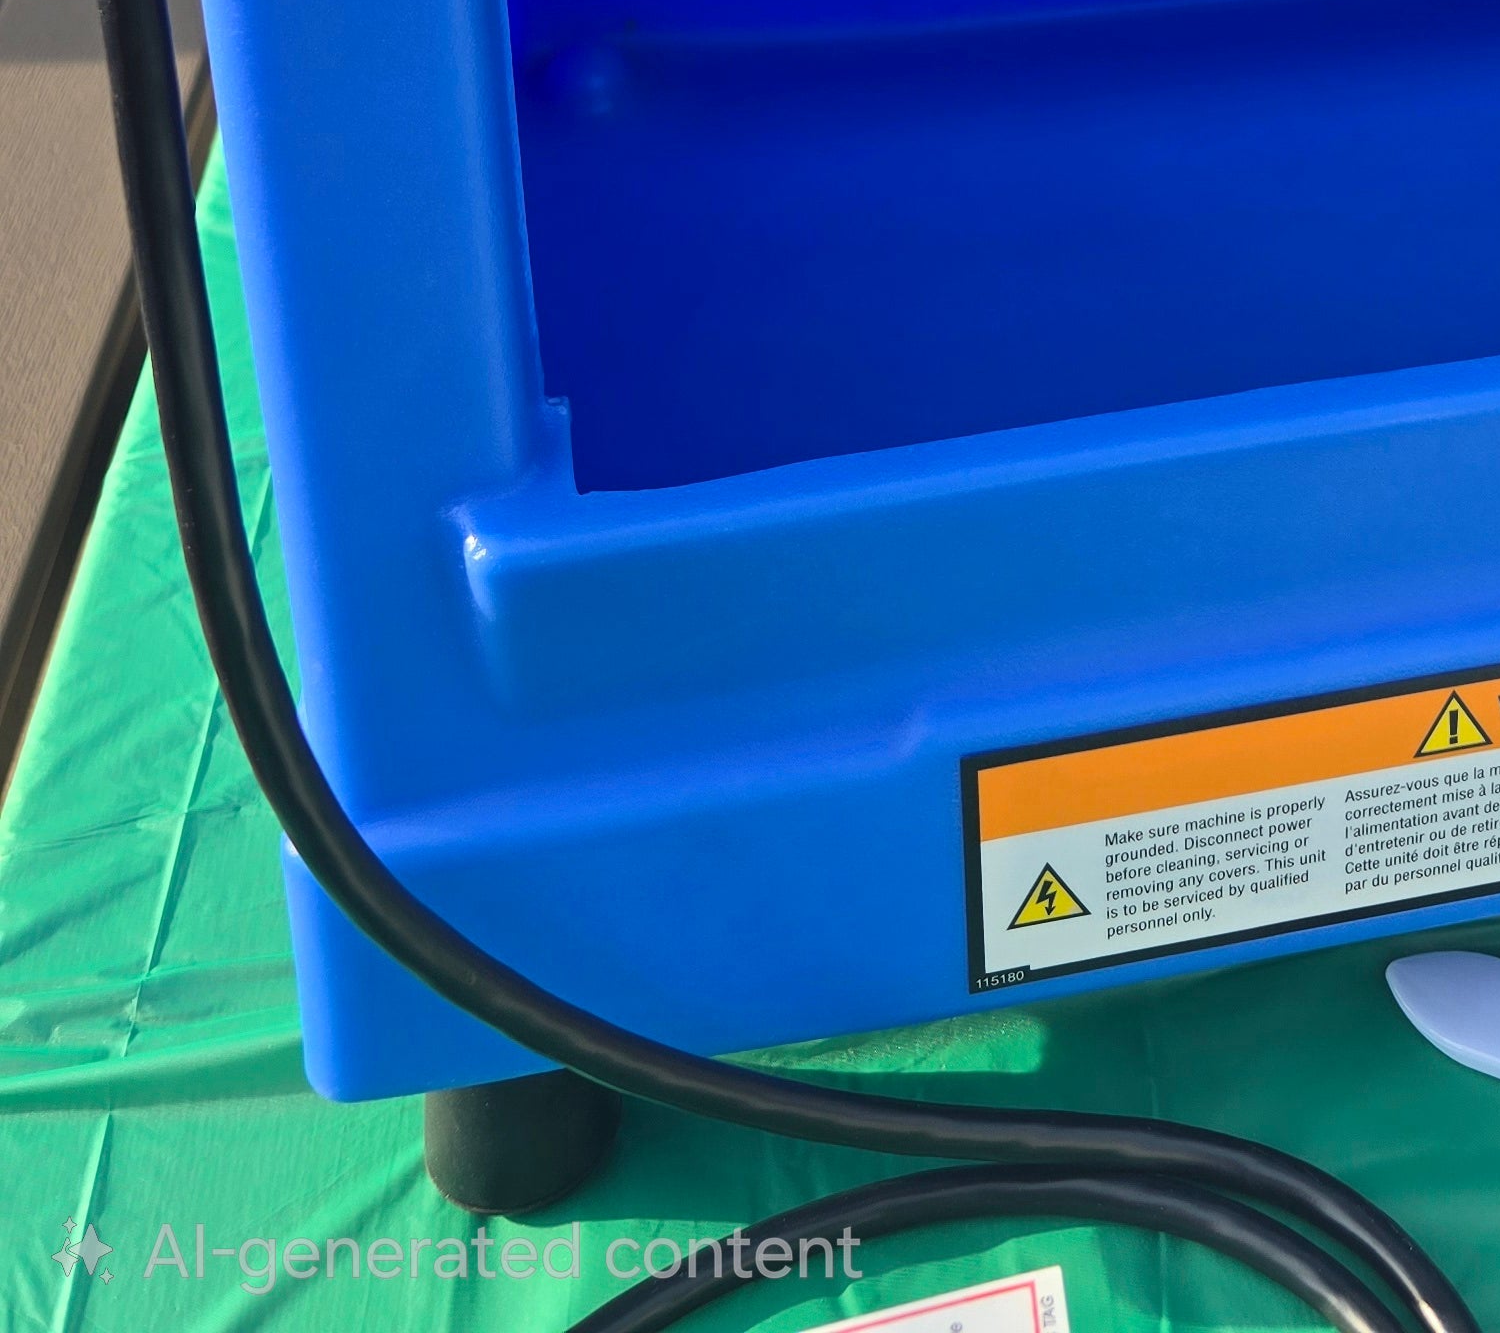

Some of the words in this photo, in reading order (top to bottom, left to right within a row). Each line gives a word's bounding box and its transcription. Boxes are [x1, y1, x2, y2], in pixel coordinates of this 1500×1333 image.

[1345, 777, 1439, 803] Assurez-vous
[1444, 771, 1468, 786] que
[1474, 767, 1485, 779] la
[1345, 793, 1437, 821] correctement
[1442, 788, 1474, 803] mise
[1478, 784, 1486, 796] à
[1105, 830, 1143, 846] Make
[1148, 824, 1179, 838] sure
[1185, 812, 1245, 831] machine
[1250, 807, 1261, 820] is
[1267, 796, 1325, 819] properly
[1442, 803, 1479, 821] avant
[1484, 800, 1500, 813] de
[1105, 840, 1178, 867] grounded.
[1184, 824, 1263, 850] Disconnect
[1269, 818, 1312, 837] power
[1429, 829, 1445, 841] ou
[1451, 824, 1467, 837] de
[1106, 866, 1151, 883] before
[1156, 854, 1219, 874] cleaning,
[1225, 840, 1288, 861] servicing
[1294, 836, 1309, 848] or
[1106, 880, 1173, 901] removing
[1178, 874, 1204, 888] any
[1208, 865, 1259, 882] covers.
[1264, 856, 1294, 871] This
[1300, 849, 1325, 865] unit
[1345, 859, 1379, 874] Cette
[1385, 849, 1418, 867] unité
[1423, 844, 1449, 860] doit
[1453, 841, 1479, 854] être
[1106, 907, 1118, 919] is
[1123, 904, 1137, 916] to
[1142, 900, 1159, 912] be
[1164, 885, 1223, 908] serviced
[1229, 883, 1245, 897] by
[1250, 869, 1308, 893] qualified
[1345, 879, 1367, 895] par
[1372, 873, 1388, 887] du
[1394, 858, 1460, 885] personnel
[1107, 912, 1177, 940] personnel
[1182, 907, 1215, 923] only.
[975, 969, 1026, 989] 115180
